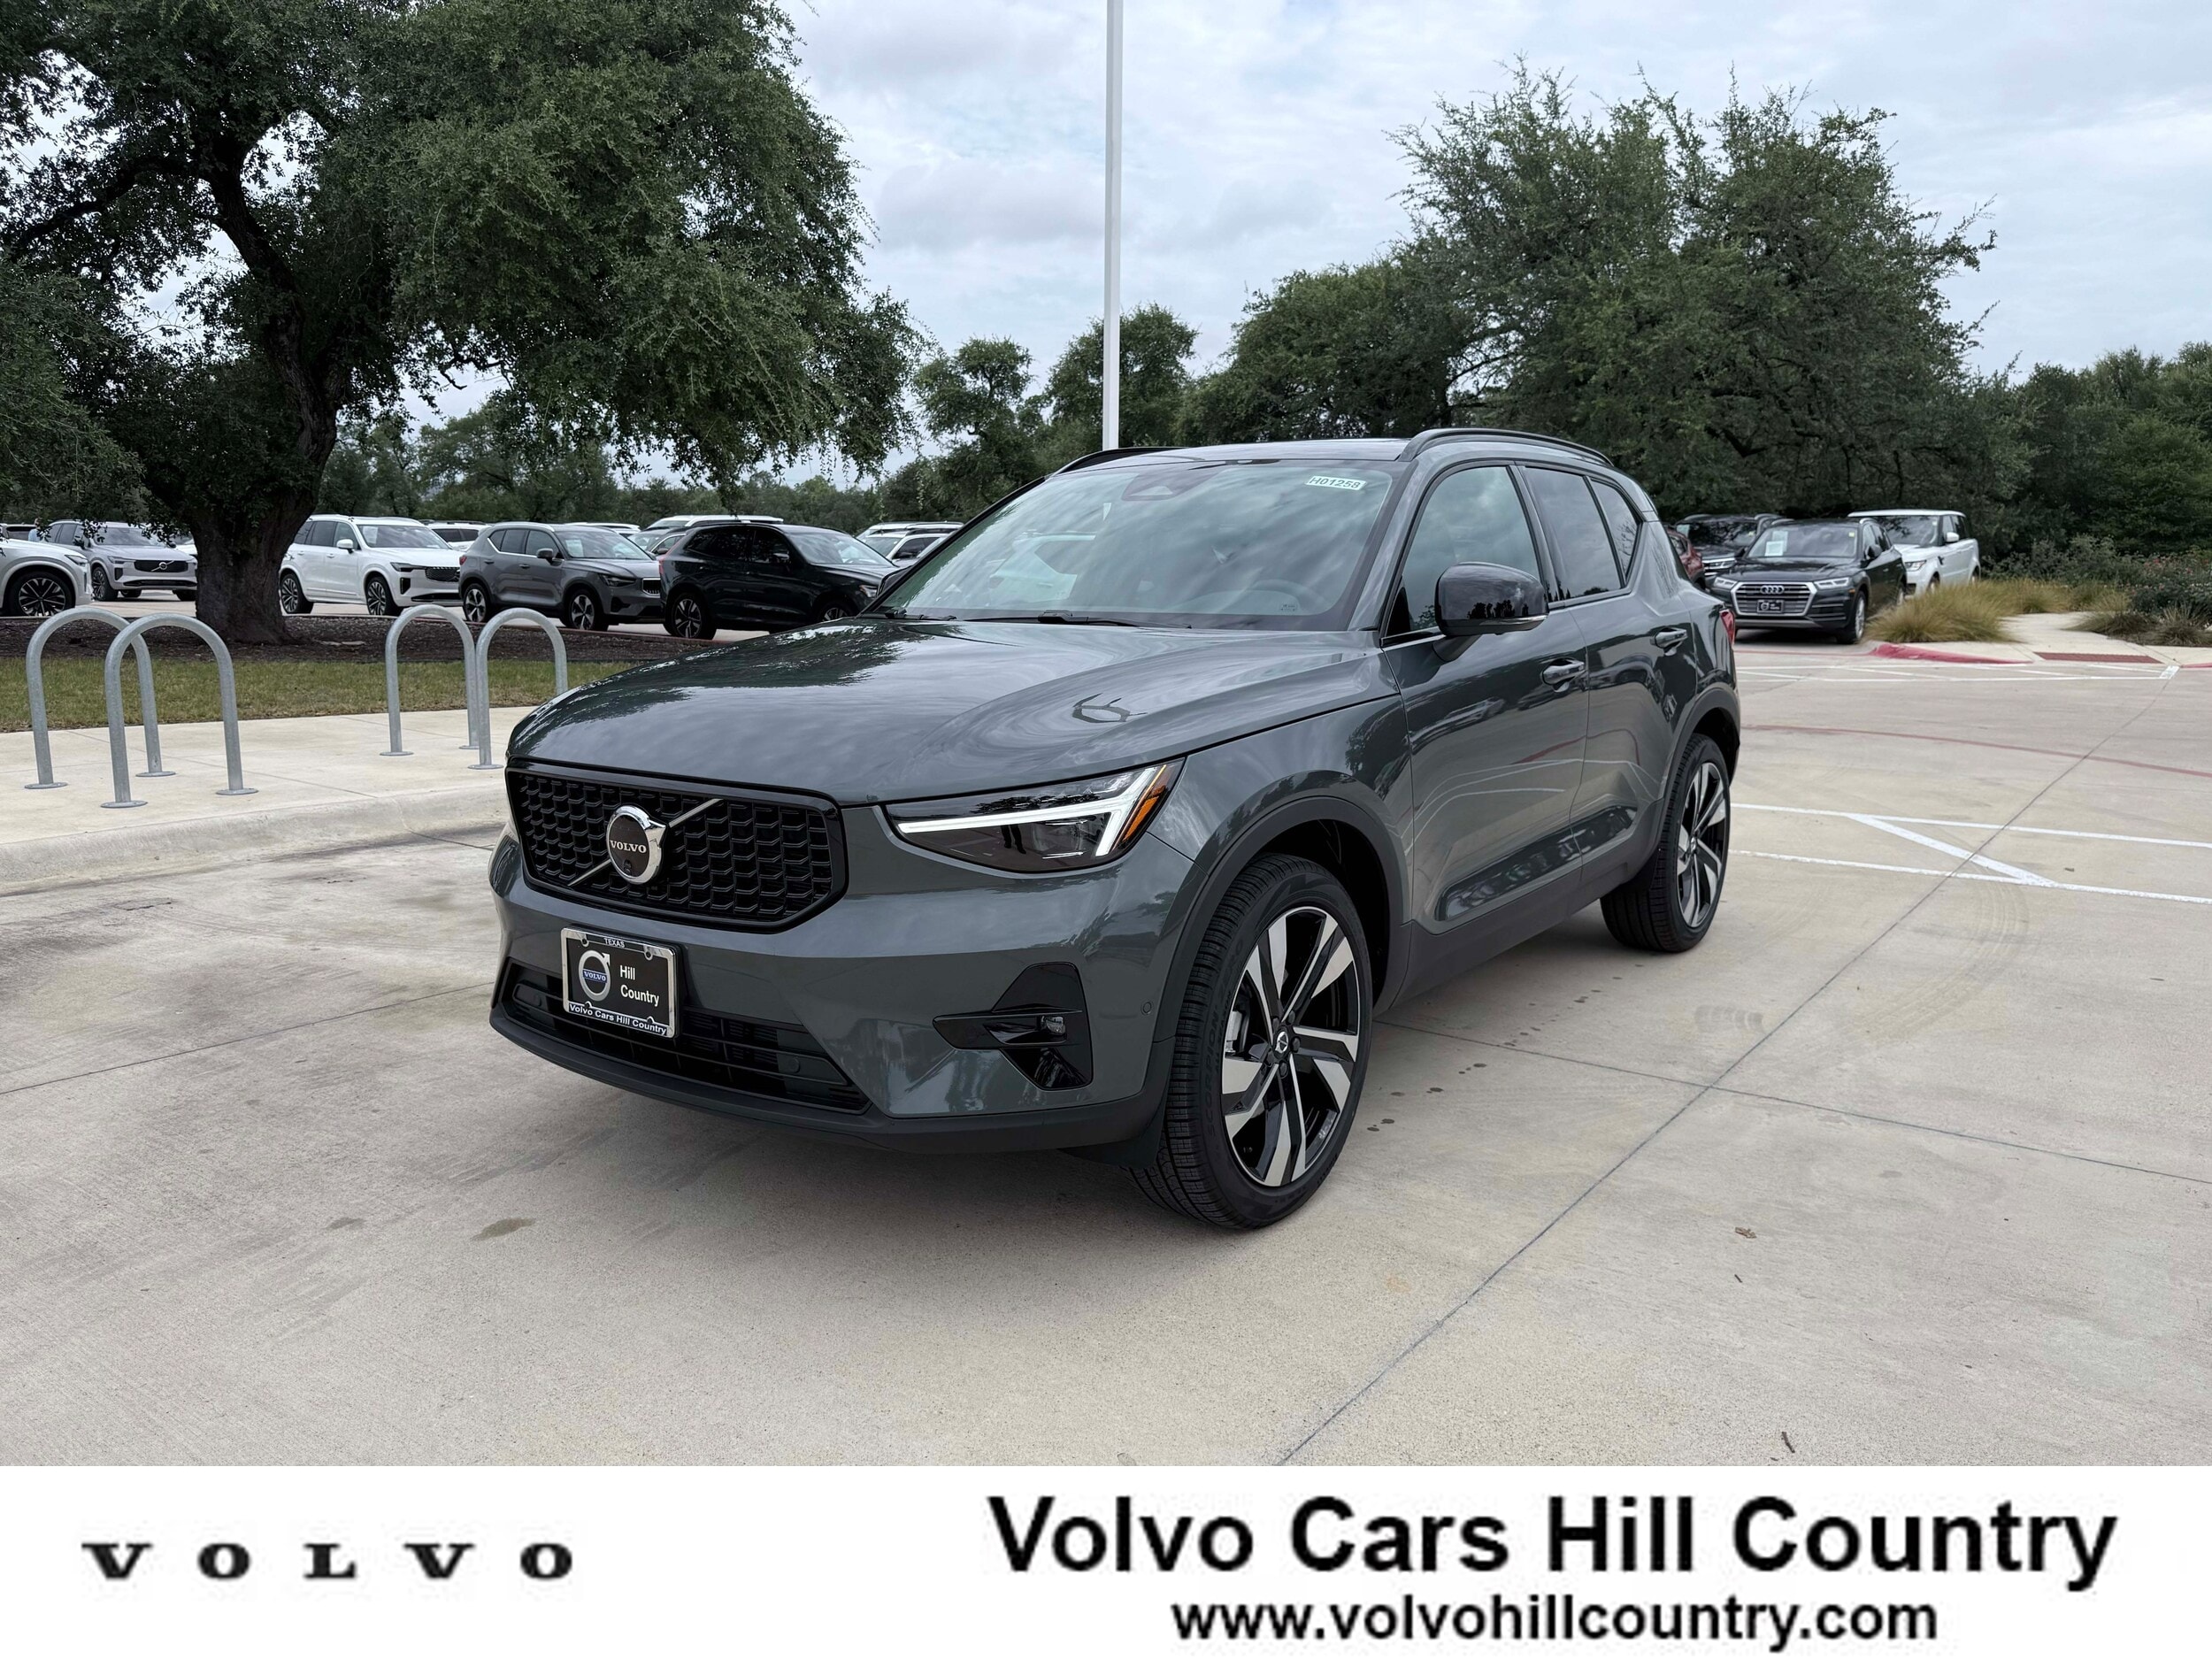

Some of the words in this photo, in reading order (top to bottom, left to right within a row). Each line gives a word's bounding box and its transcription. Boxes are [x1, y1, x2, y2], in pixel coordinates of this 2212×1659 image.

[1309, 477, 1361, 488] H01258
[610, 840, 647, 854] VOLVO
[603, 938, 626, 949] TEXAS
[584, 971, 607, 982] VOLVO
[619, 965, 635, 980] Hill
[620, 984, 660, 1007] Country
[569, 1003, 593, 1016] Volvo
[595, 1010, 614, 1021] Cars
[616, 1017, 630, 1026] Hill
[632, 1020, 666, 1035] Country
[1204, 1010, 1219, 1138] SCORPION
